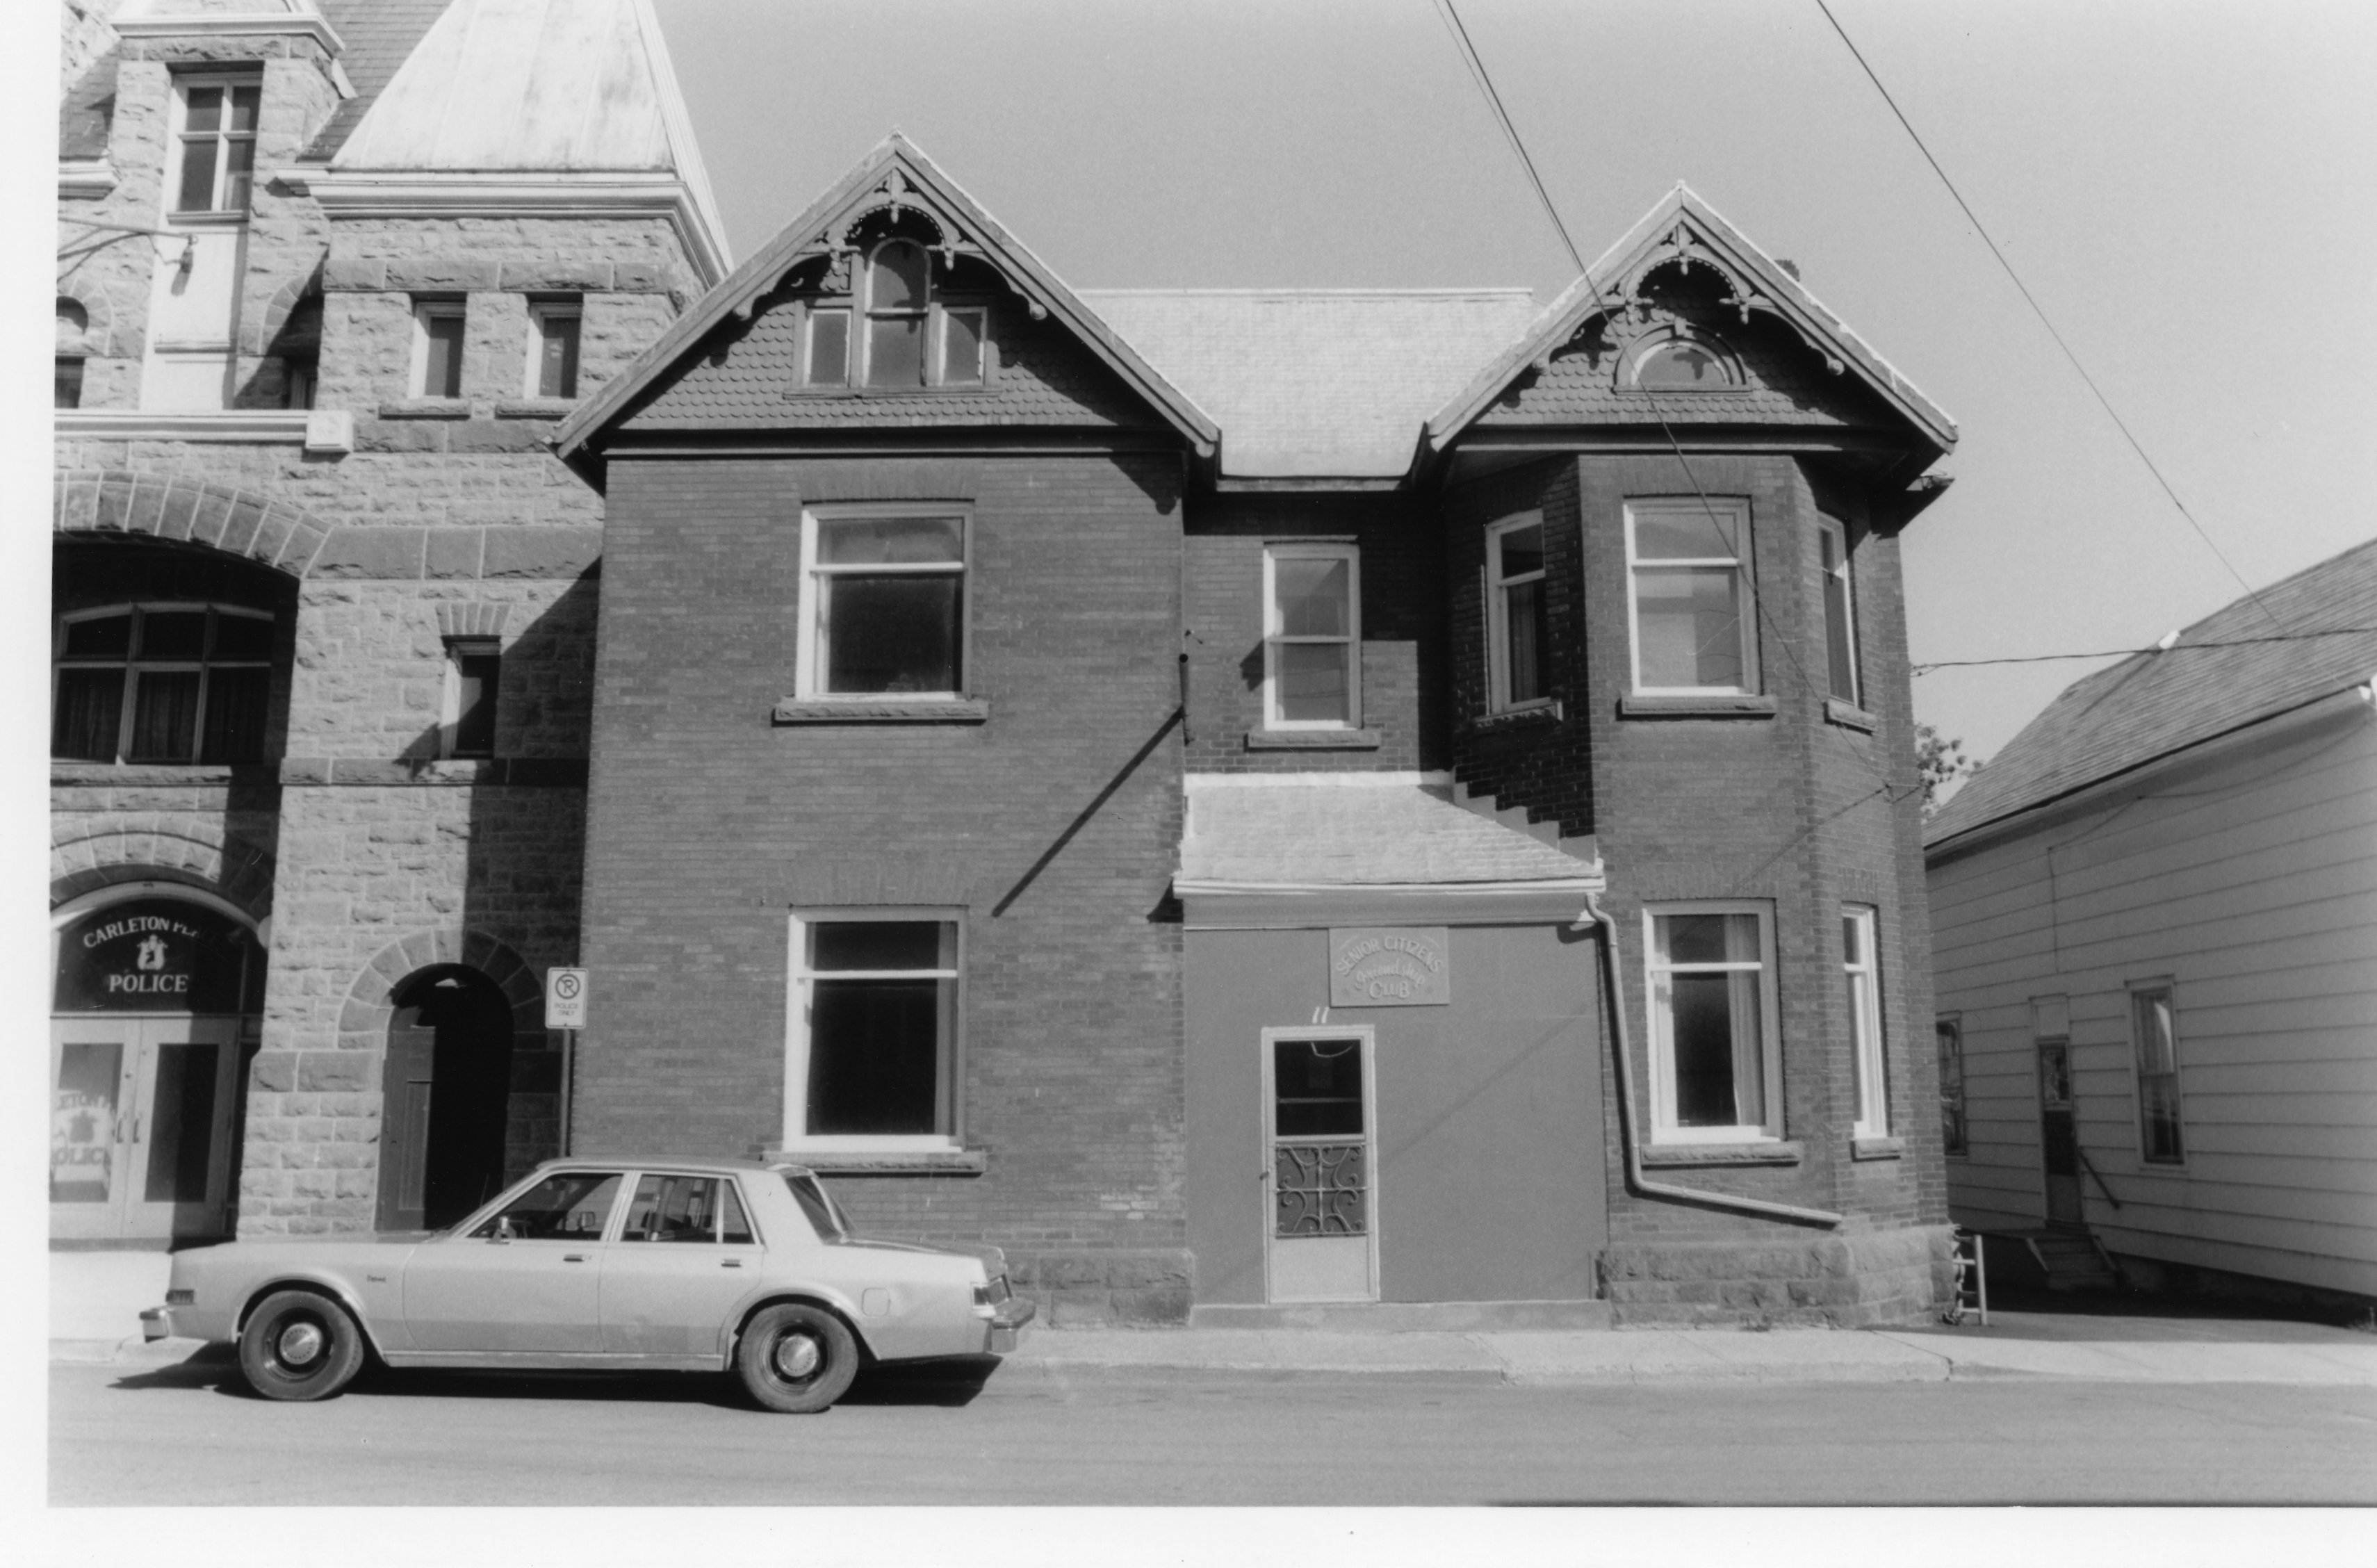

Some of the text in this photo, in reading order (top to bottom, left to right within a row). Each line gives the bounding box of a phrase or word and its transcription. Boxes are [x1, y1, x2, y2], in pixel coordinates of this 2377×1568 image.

[83, 917, 170, 948] CARLETON
[1336, 936, 1443, 977] SENIOR CITIZENS
[108, 974, 189, 993] POLICE
[1312, 1006, 1330, 1024] 11
